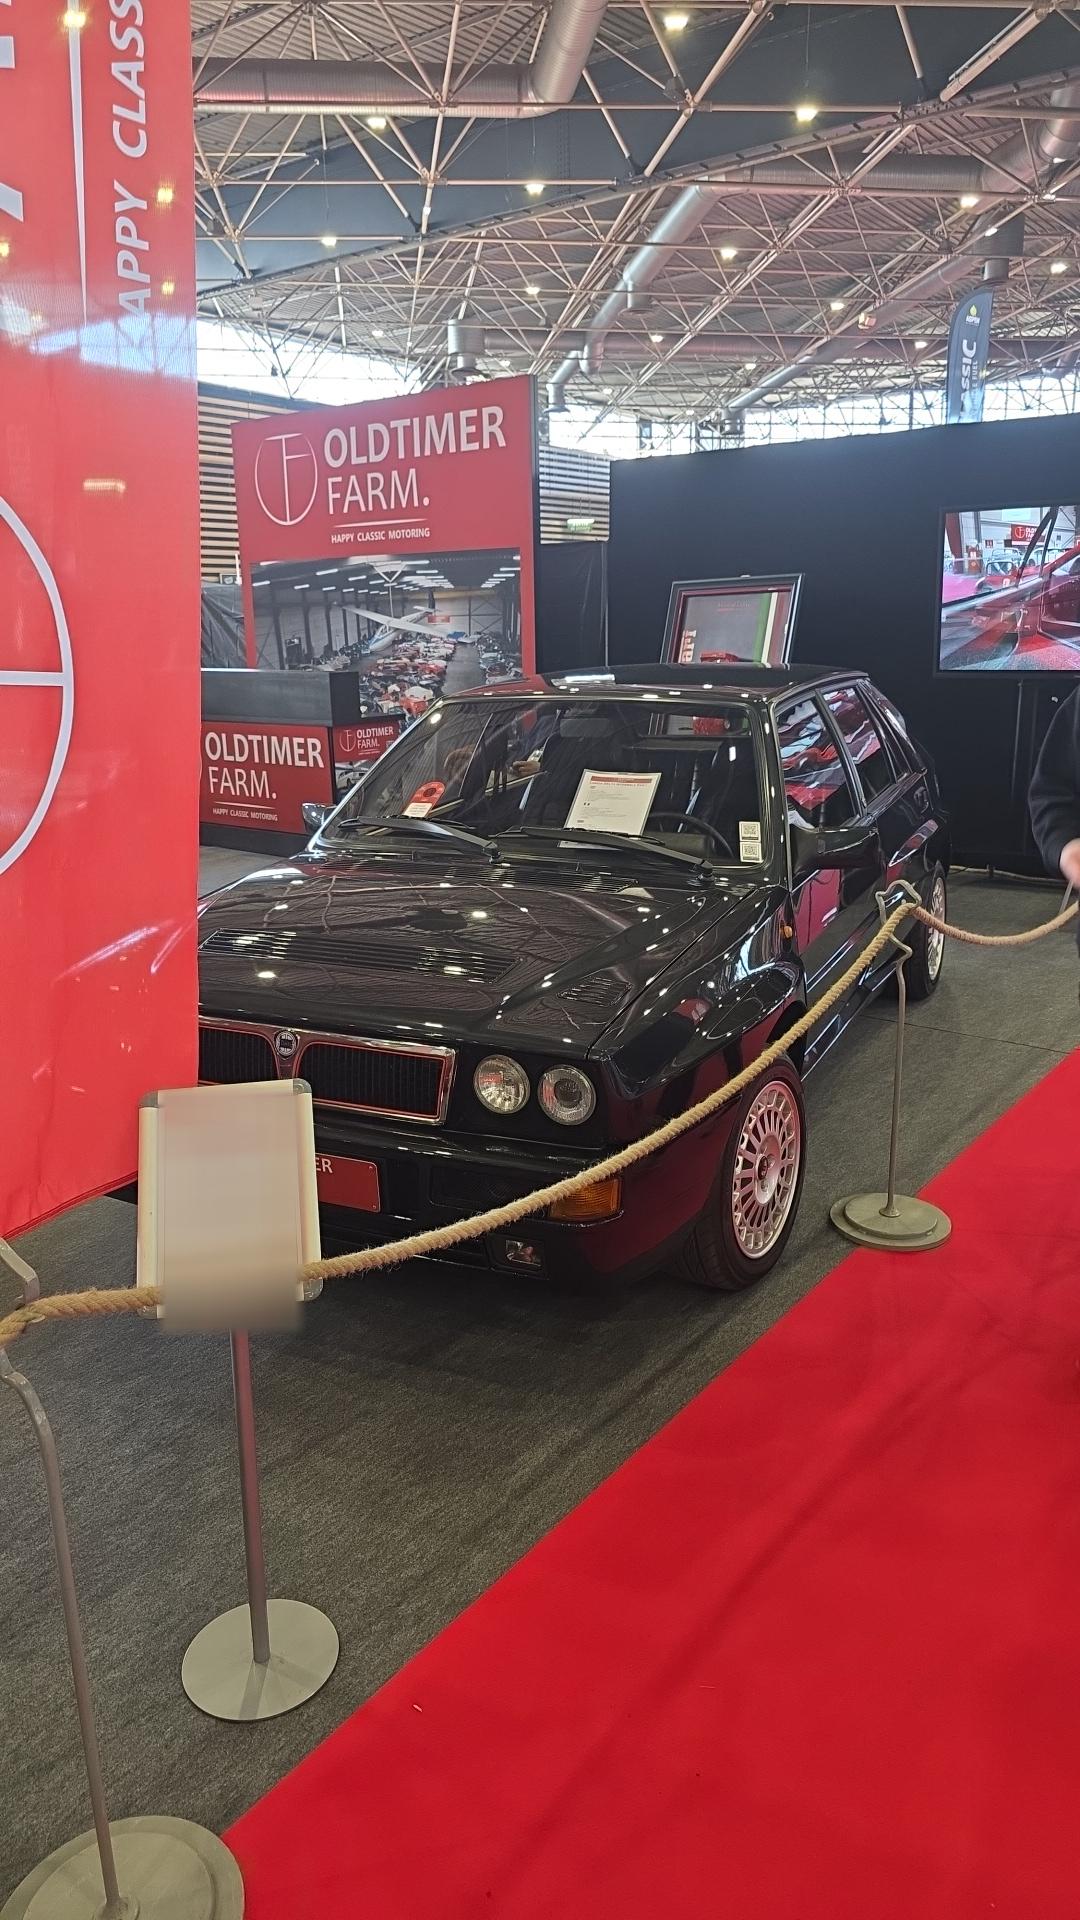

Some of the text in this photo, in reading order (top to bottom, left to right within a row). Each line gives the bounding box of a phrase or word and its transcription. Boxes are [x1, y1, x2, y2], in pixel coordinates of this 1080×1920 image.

[323, 405, 506, 468] OLDTIMER
[327, 468, 430, 515] FARM.
[331, 527, 430, 544] HAPPY CLASSIC MOTORING
[356, 726, 394, 739] OLDTIMER
[357, 738, 380, 749] FARM.
[204, 731, 325, 768] OLDTIMER
[208, 766, 277, 800] FARM.
[212, 807, 278, 821] HAPPY CLASSIC MOTORING
